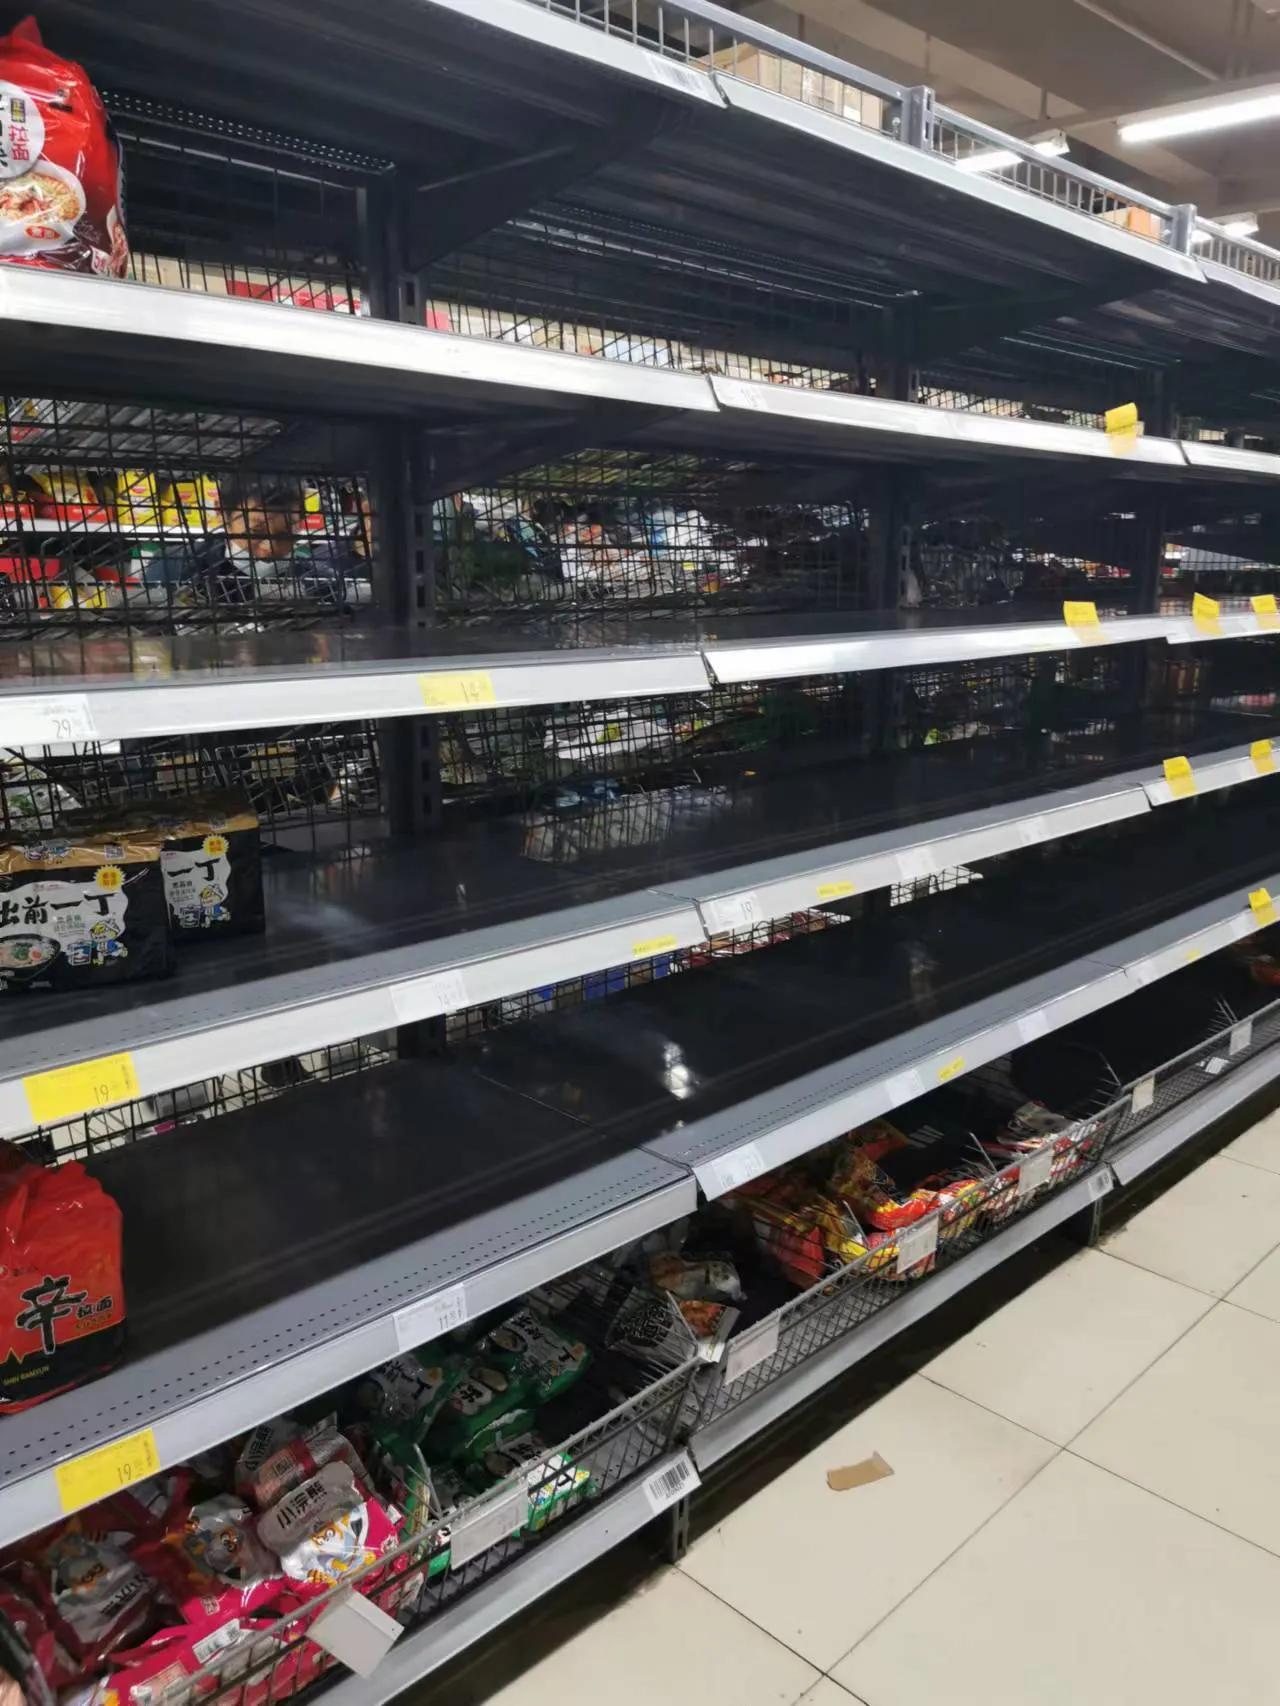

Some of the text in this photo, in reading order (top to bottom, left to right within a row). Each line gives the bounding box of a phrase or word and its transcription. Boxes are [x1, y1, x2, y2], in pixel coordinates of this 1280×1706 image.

[9, 125, 30, 161] 拉面
[51, 719, 72, 739] 29
[167, 858, 220, 882] 一丁
[0, 892, 119, 928] 出前一丁
[94, 1084, 109, 1105] 19
[16, 1275, 88, 1354] 辛
[118, 1463, 132, 1484] 19
[276, 1480, 328, 1530] 小浣熊
